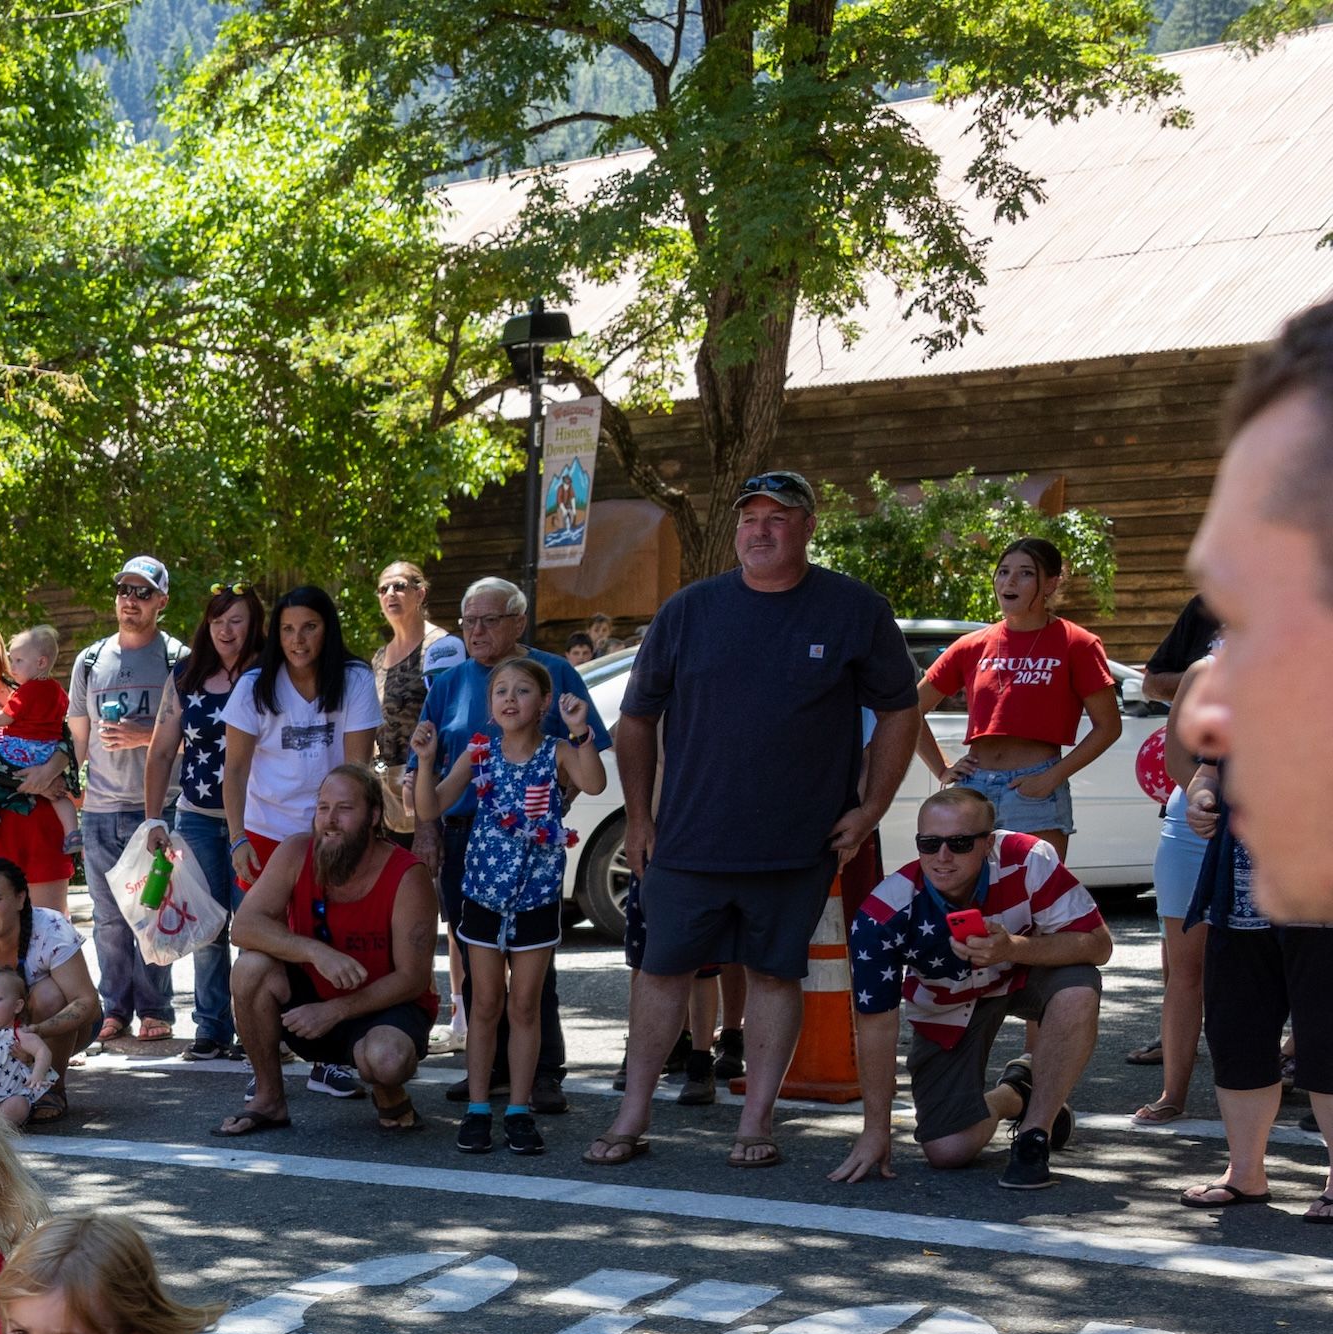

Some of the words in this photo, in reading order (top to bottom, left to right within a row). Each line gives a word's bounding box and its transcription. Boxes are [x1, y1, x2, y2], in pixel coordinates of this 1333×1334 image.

[555, 427, 591, 440] Historic
[978, 657, 1061, 671] TRUMP
[1013, 671, 1052, 685] 2024
[96, 690, 151, 717] USA
